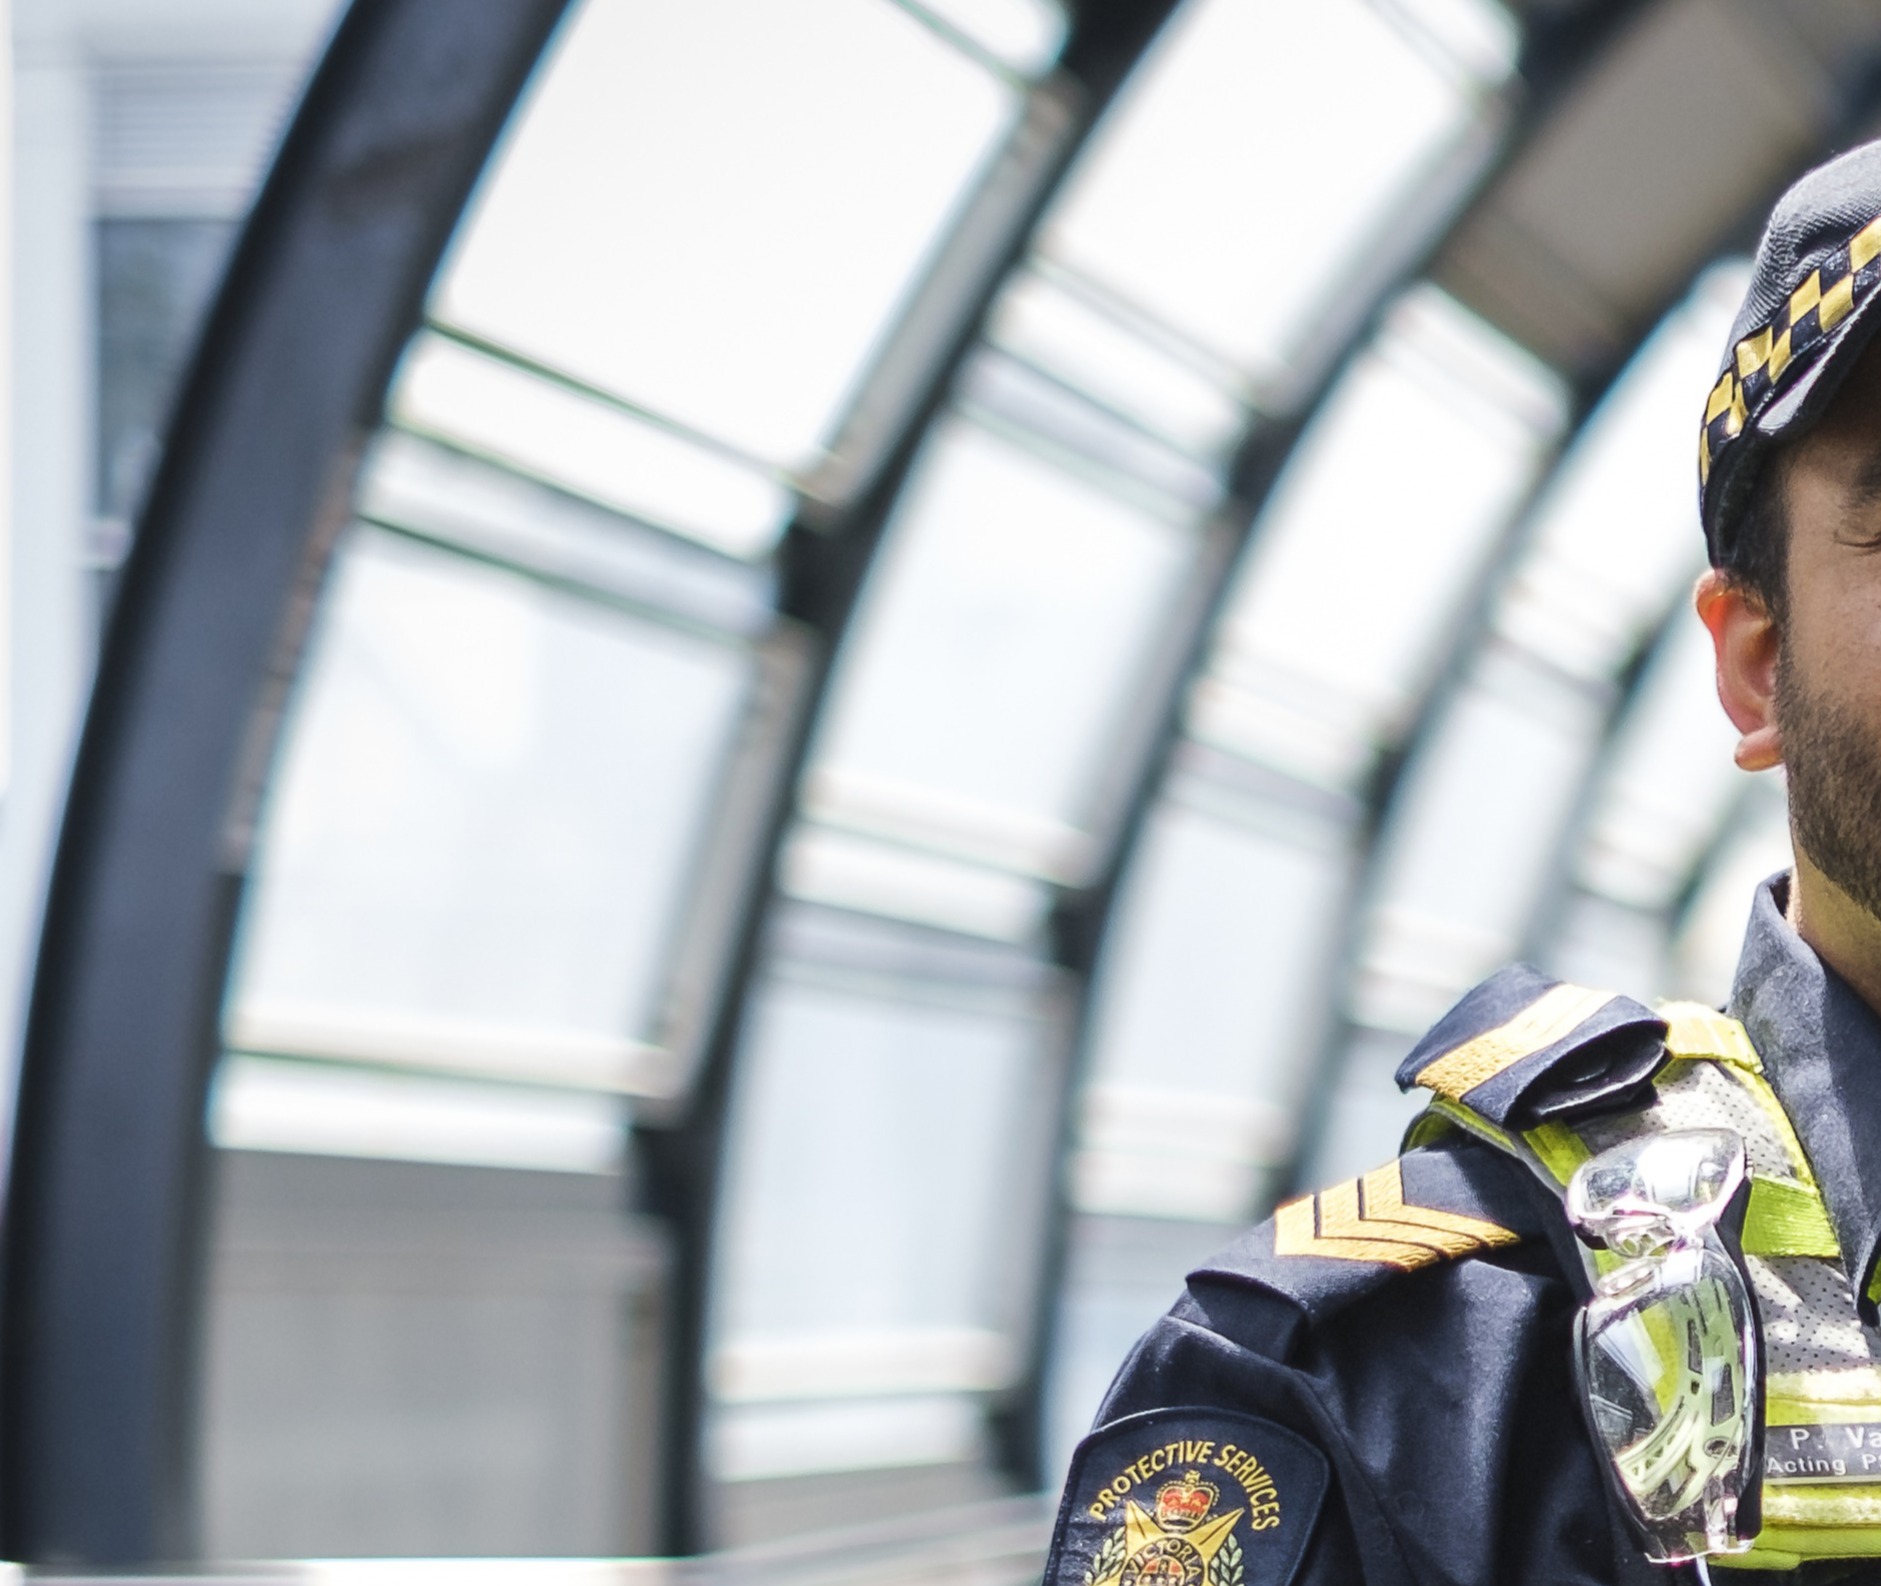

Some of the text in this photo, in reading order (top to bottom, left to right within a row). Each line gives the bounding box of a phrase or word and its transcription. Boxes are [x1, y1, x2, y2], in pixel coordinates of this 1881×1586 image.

[1789, 1427, 1824, 1451] P.
[1766, 1456, 1847, 1476] Acting
[1088, 1440, 1280, 1532] PROTECTIVE SERVICES
[1125, 1538, 1202, 1578] VICTORIA
